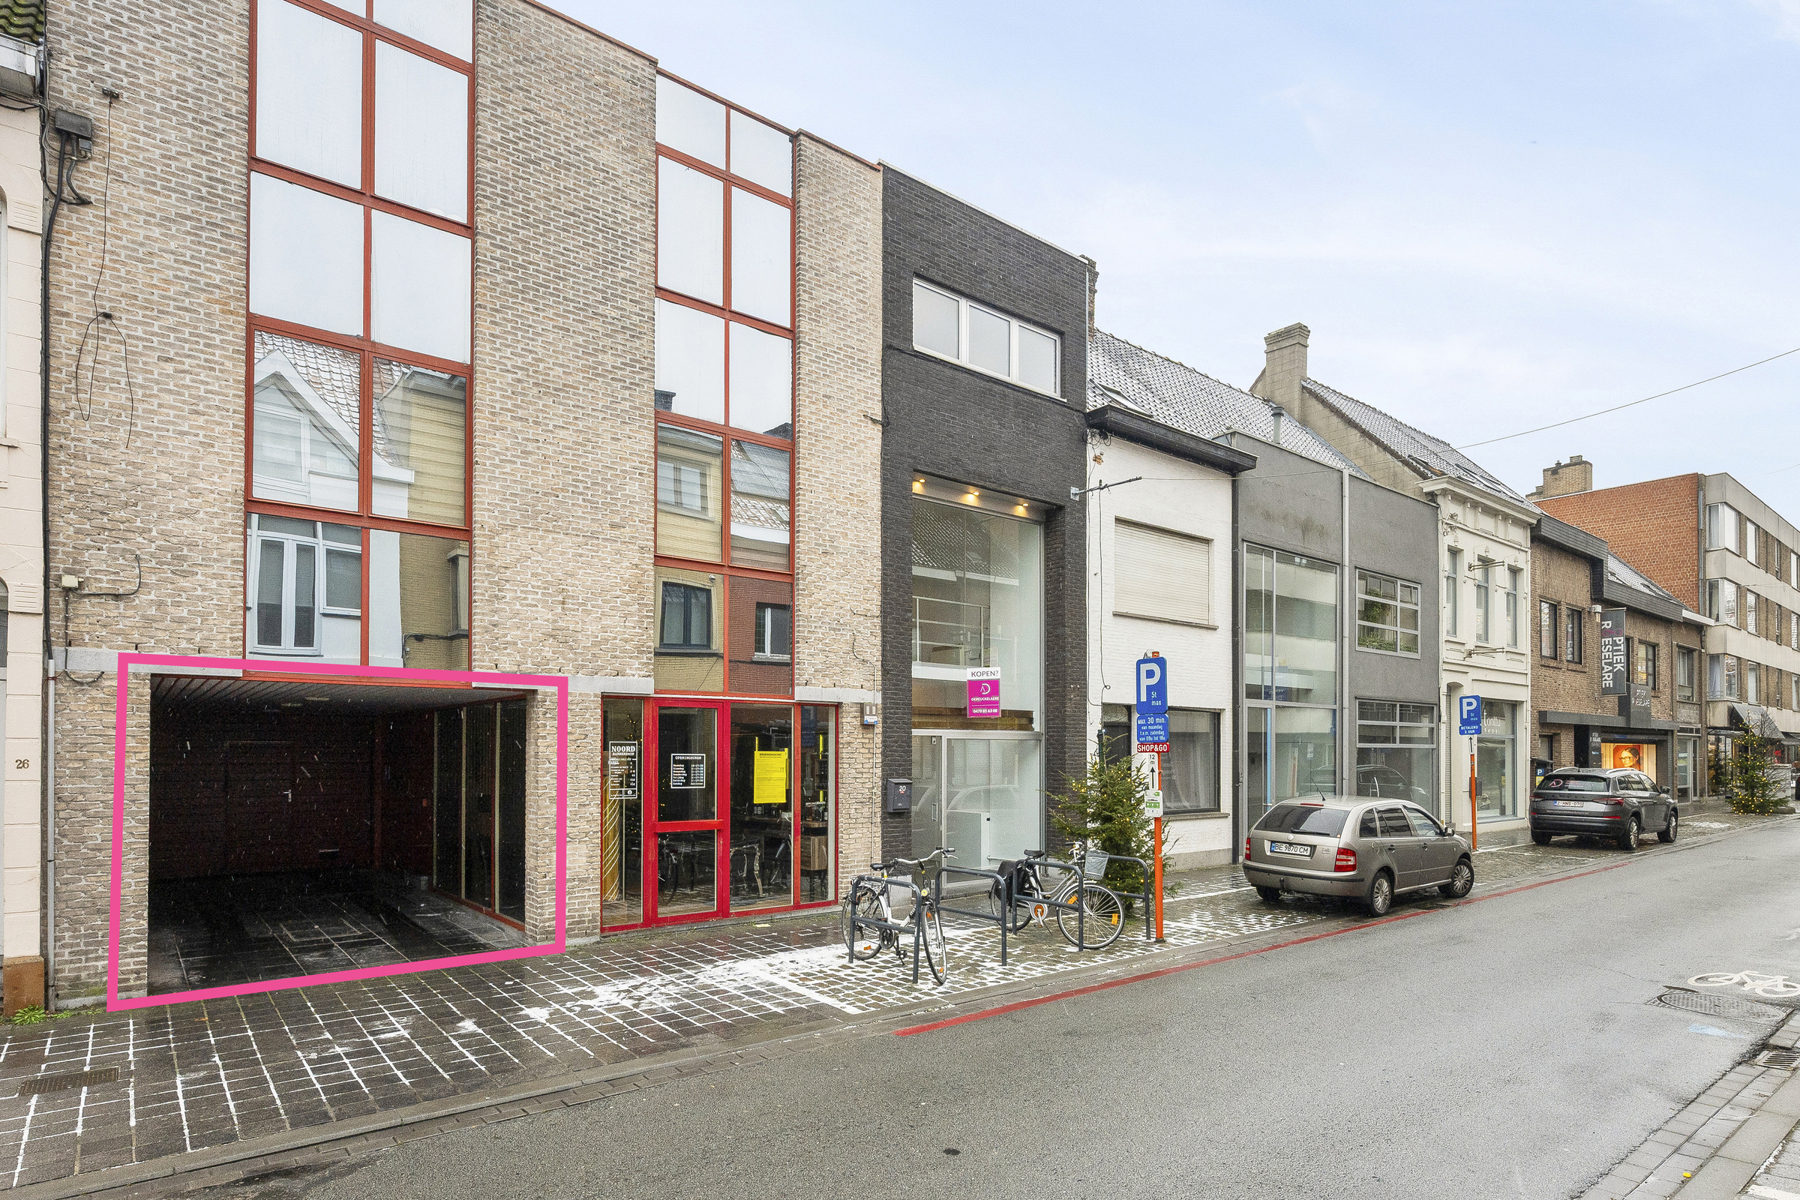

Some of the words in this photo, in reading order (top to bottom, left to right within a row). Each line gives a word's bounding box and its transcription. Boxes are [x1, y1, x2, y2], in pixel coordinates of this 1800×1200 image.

[1140, 662, 1161, 702] P
[1462, 698, 1477, 719] P
[611, 745, 636, 753] NOORD
[1137, 744, 1168, 752] SHOP&GO
[15, 759, 29, 769] 26
[1299, 846, 1309, 854] CM
